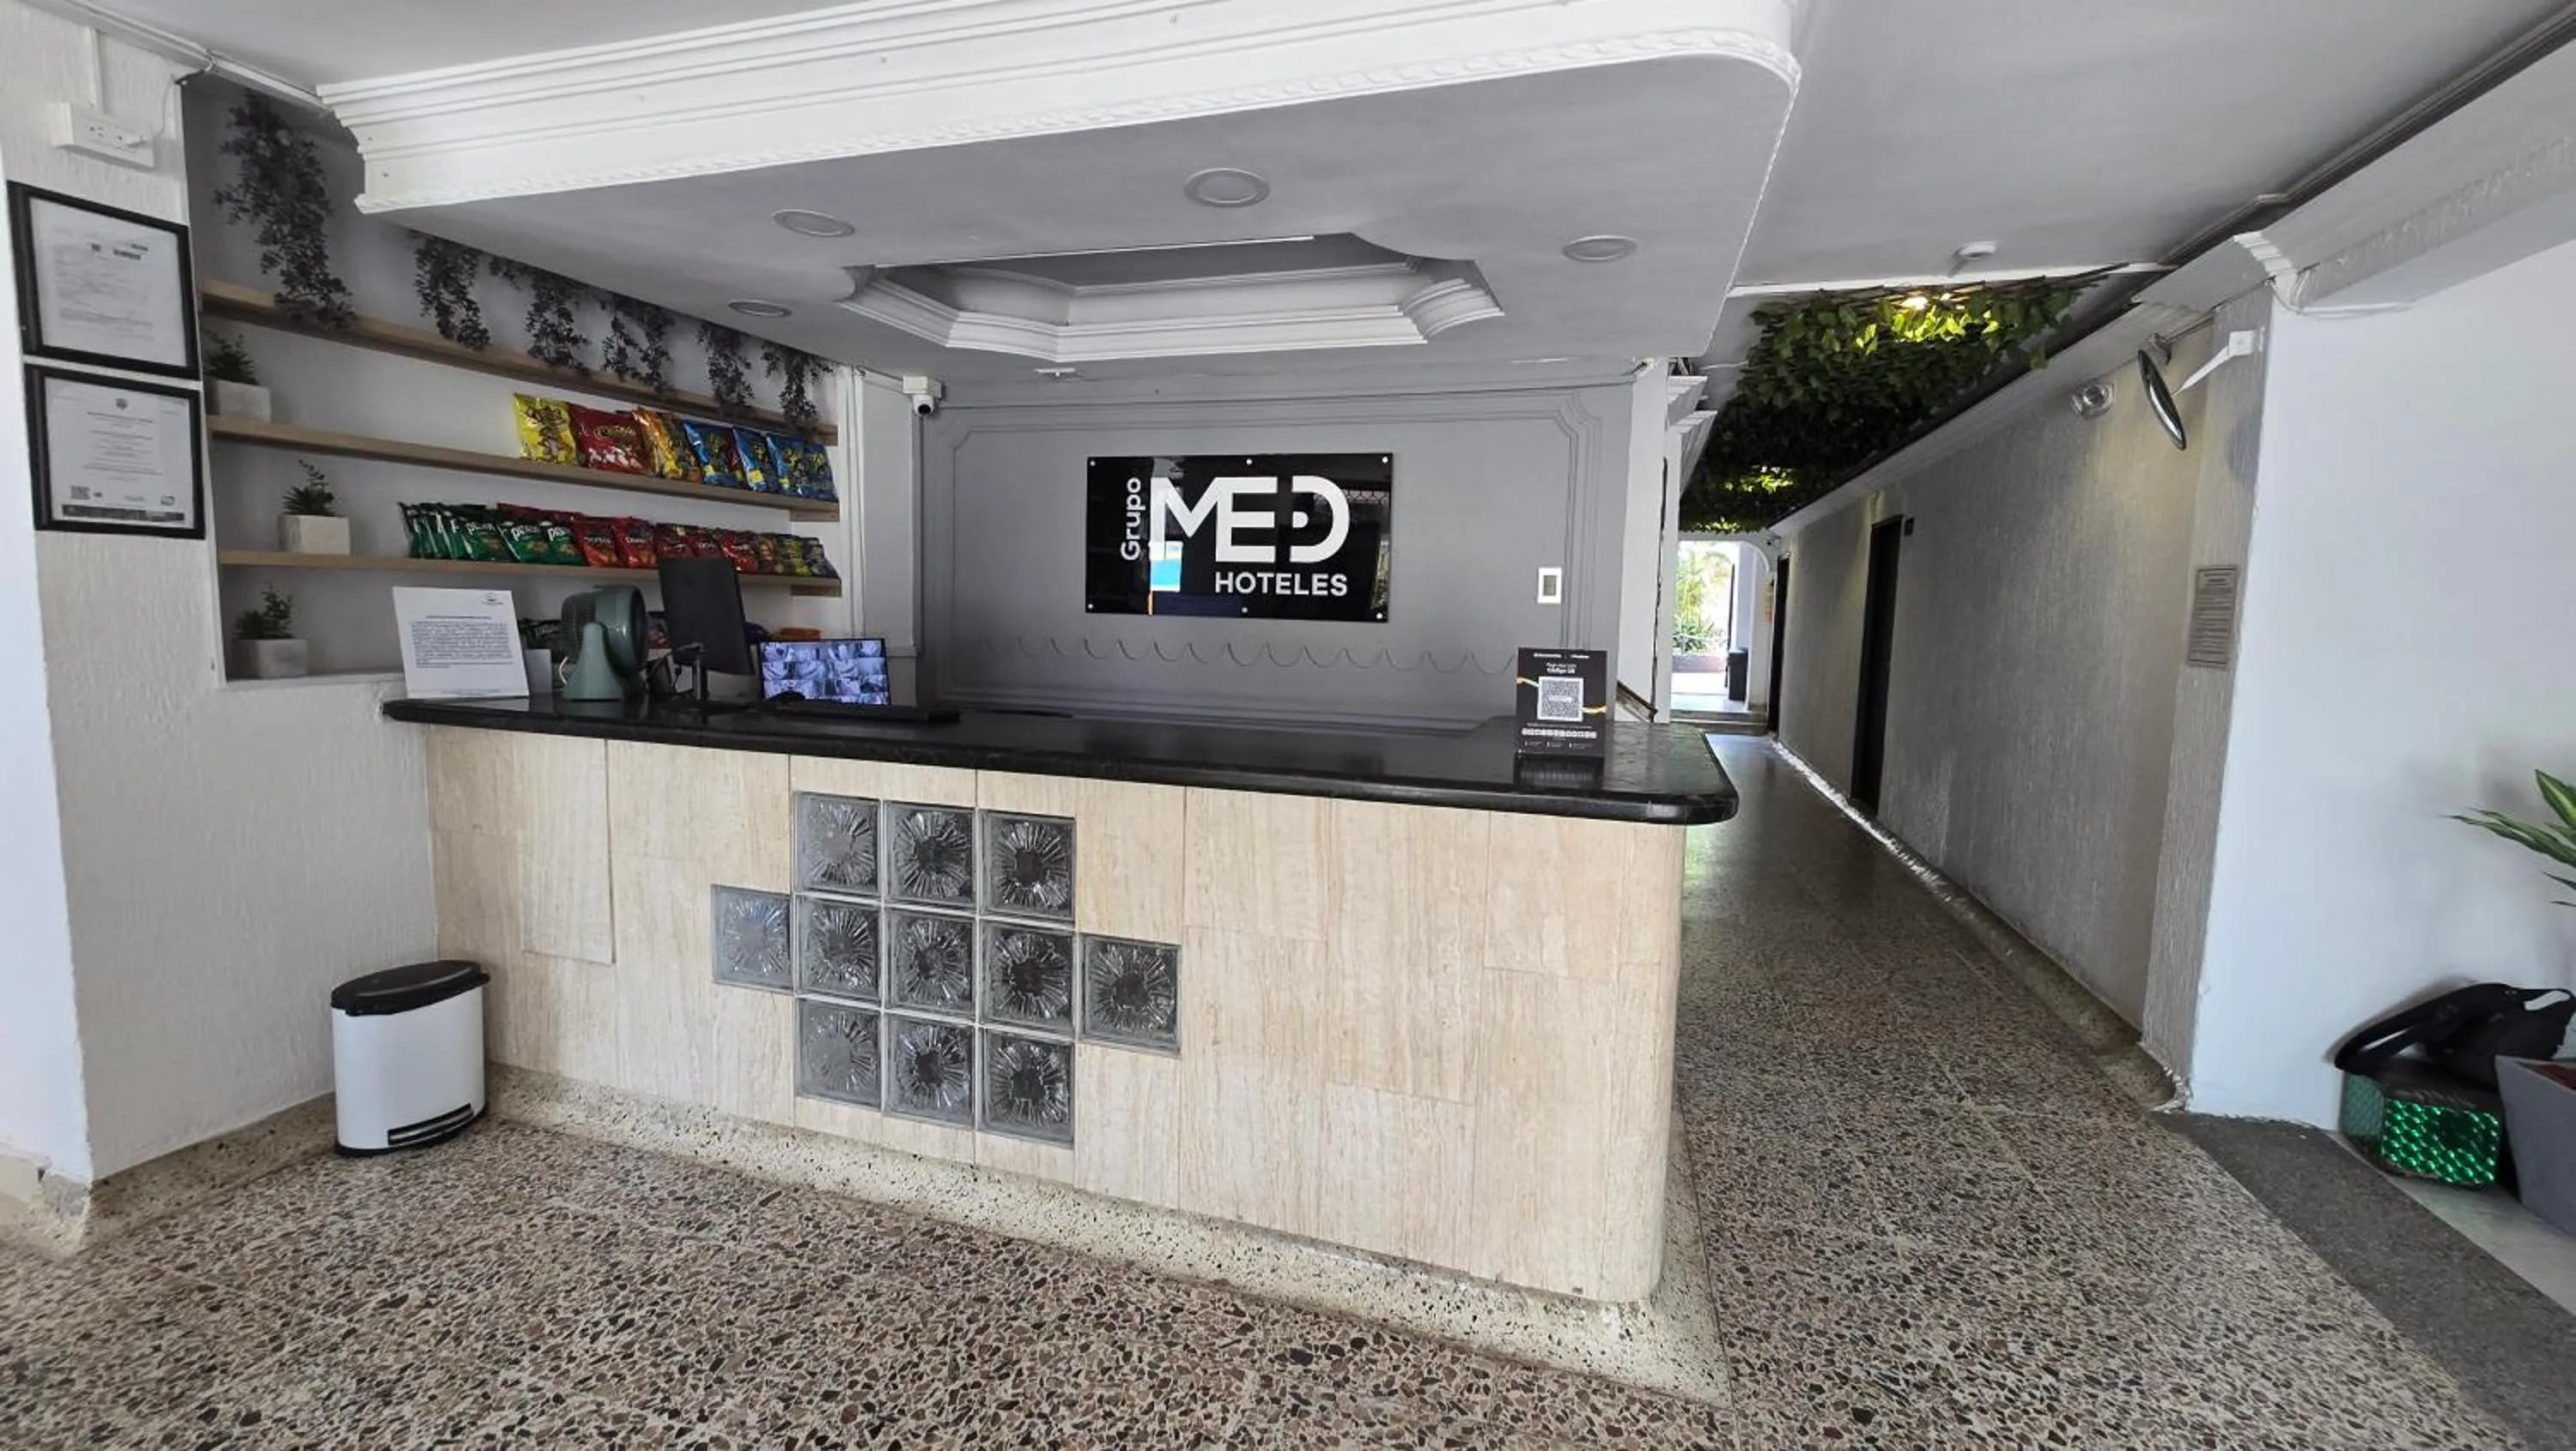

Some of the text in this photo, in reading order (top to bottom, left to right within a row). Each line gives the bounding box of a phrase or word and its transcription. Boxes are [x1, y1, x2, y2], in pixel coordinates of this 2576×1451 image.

[1121, 477, 1146, 562] Grupo
[1150, 475, 1351, 562] MED
[1214, 571, 1348, 598] HOTELES
